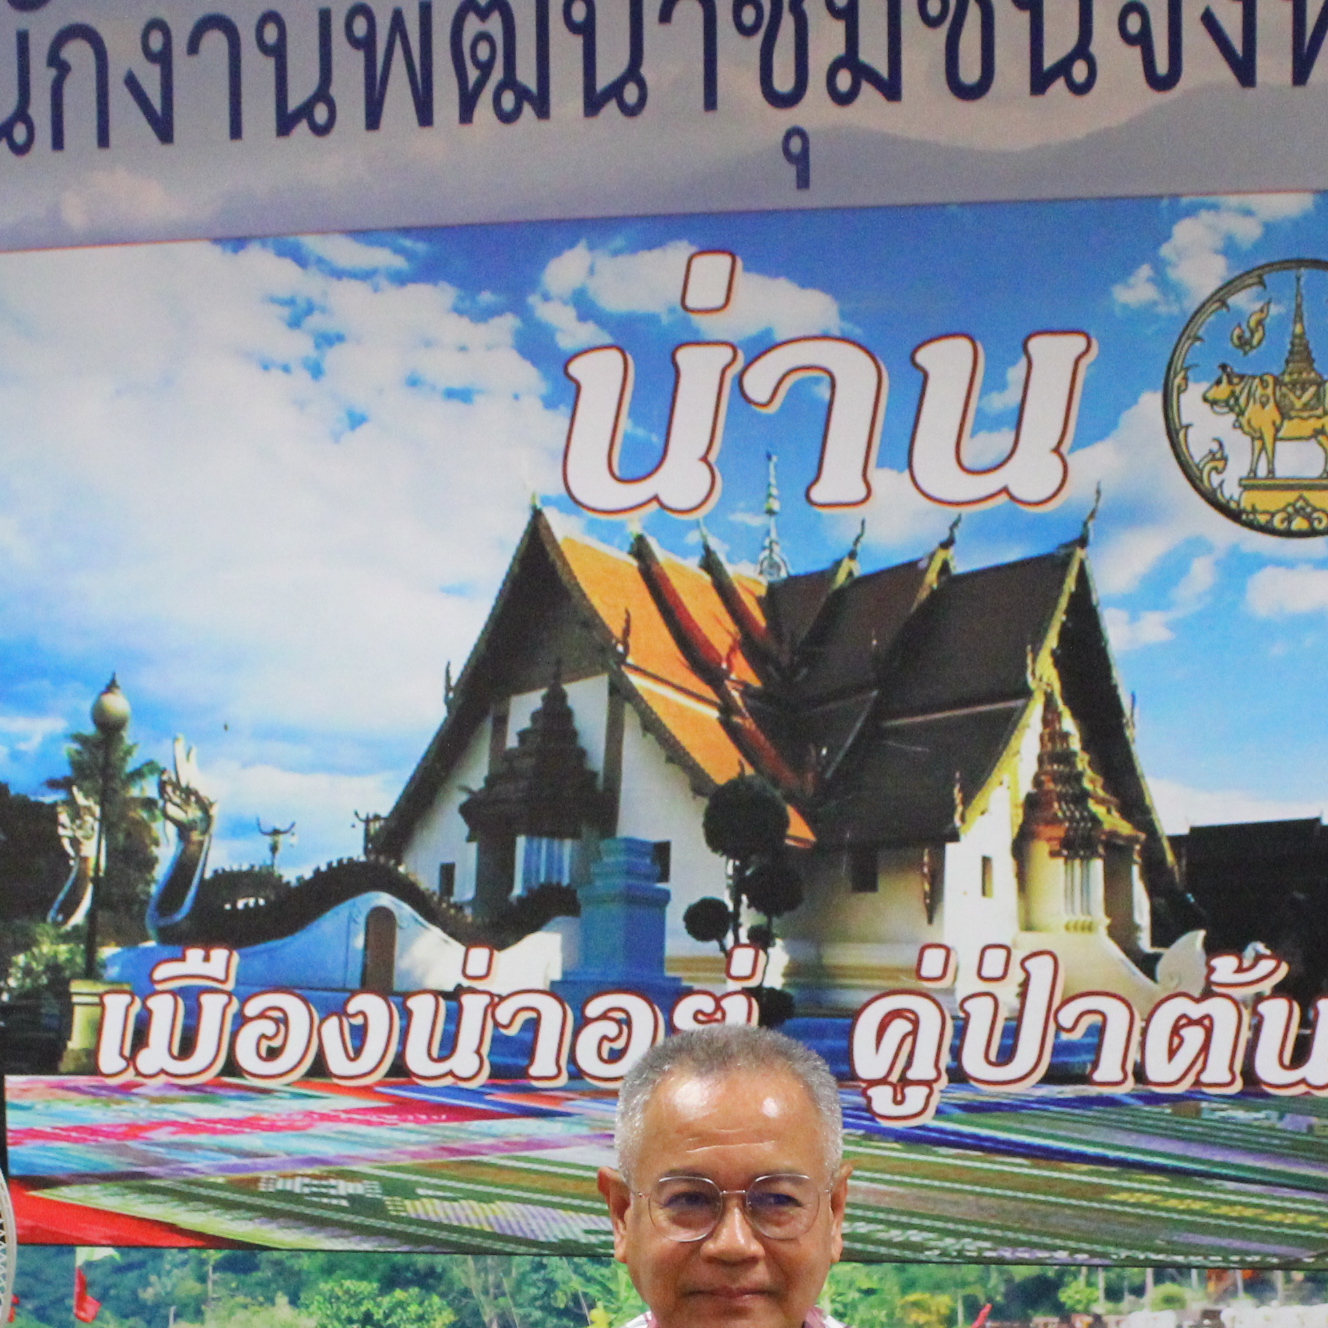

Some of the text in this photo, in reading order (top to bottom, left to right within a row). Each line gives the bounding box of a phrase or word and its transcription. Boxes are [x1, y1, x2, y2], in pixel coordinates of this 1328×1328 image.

[563, 250, 1094, 514] น่าน
[97, 944, 762, 1084] เมืองน่าอ่
